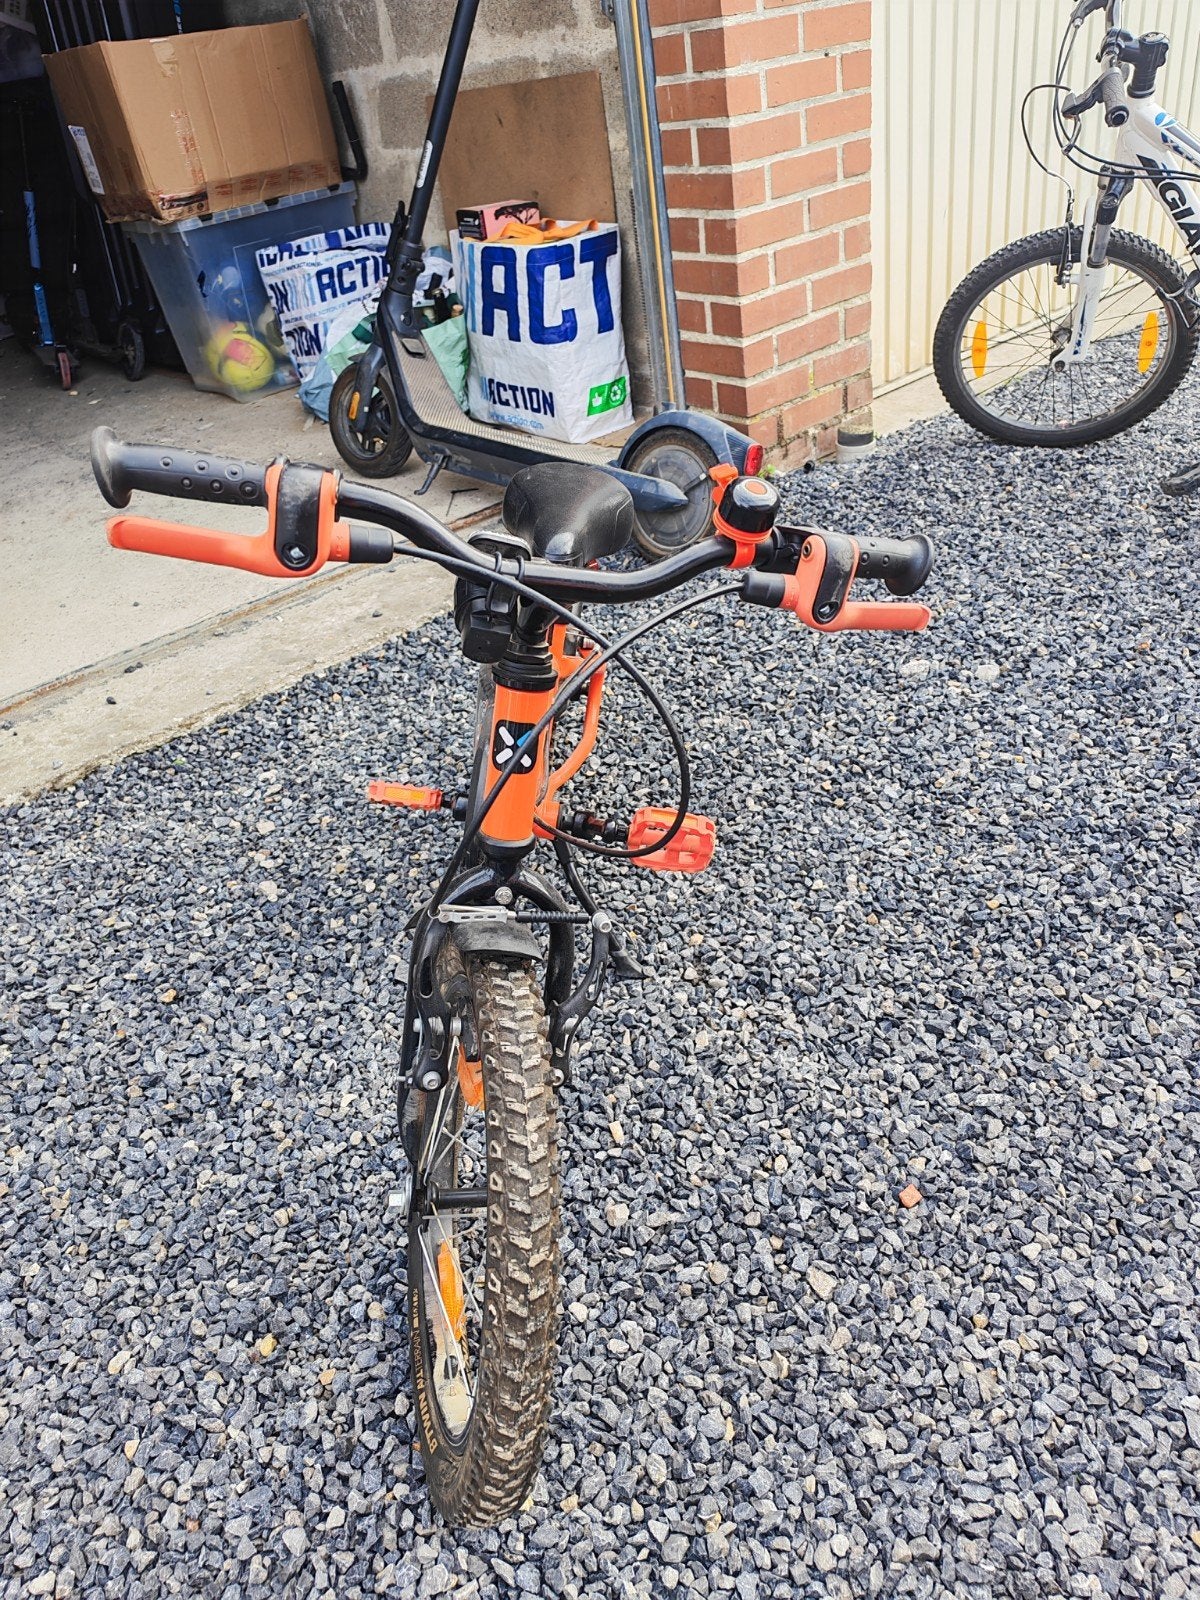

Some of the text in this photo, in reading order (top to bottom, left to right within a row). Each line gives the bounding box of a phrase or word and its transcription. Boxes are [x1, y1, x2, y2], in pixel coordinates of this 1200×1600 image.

[1159, 182, 1200, 255] GIA
[481, 230, 618, 345] ACT
[487, 377, 555, 418] ACTION
